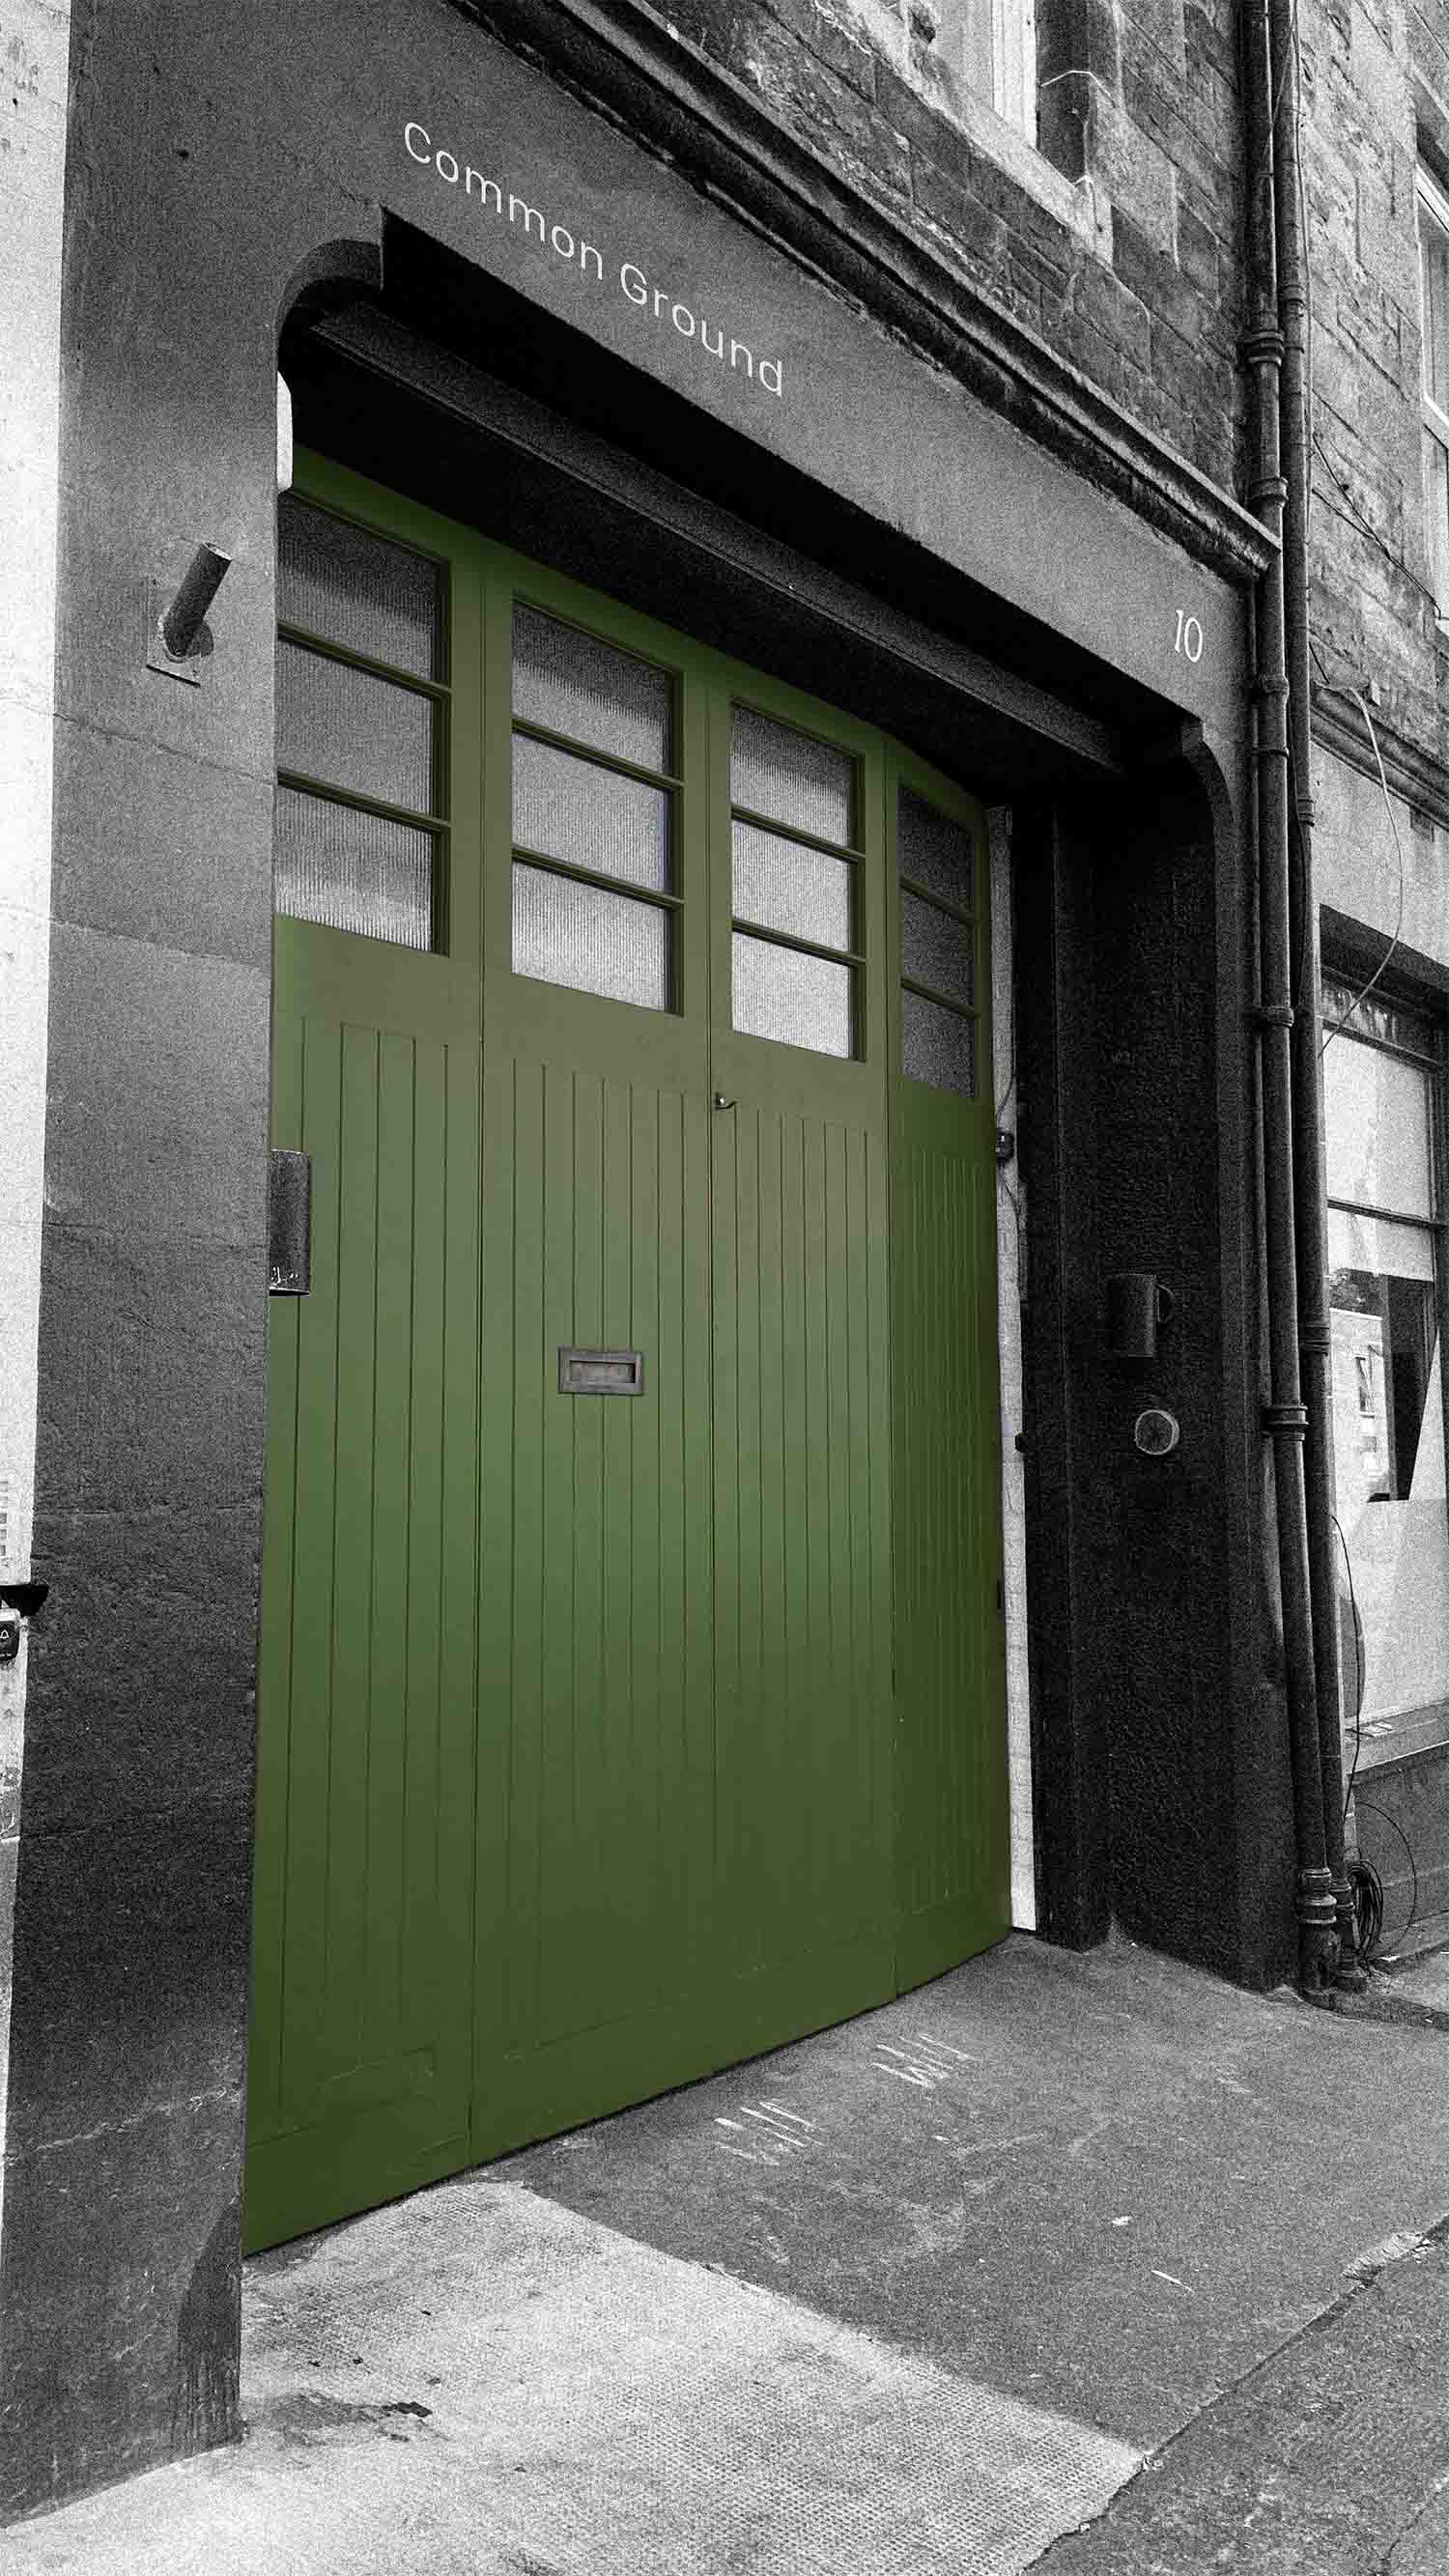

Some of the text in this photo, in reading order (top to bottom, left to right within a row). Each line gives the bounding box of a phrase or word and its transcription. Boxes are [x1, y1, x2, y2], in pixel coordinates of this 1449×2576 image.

[404, 122, 782, 397] Common Ground
[1175, 609, 1203, 663] 10
